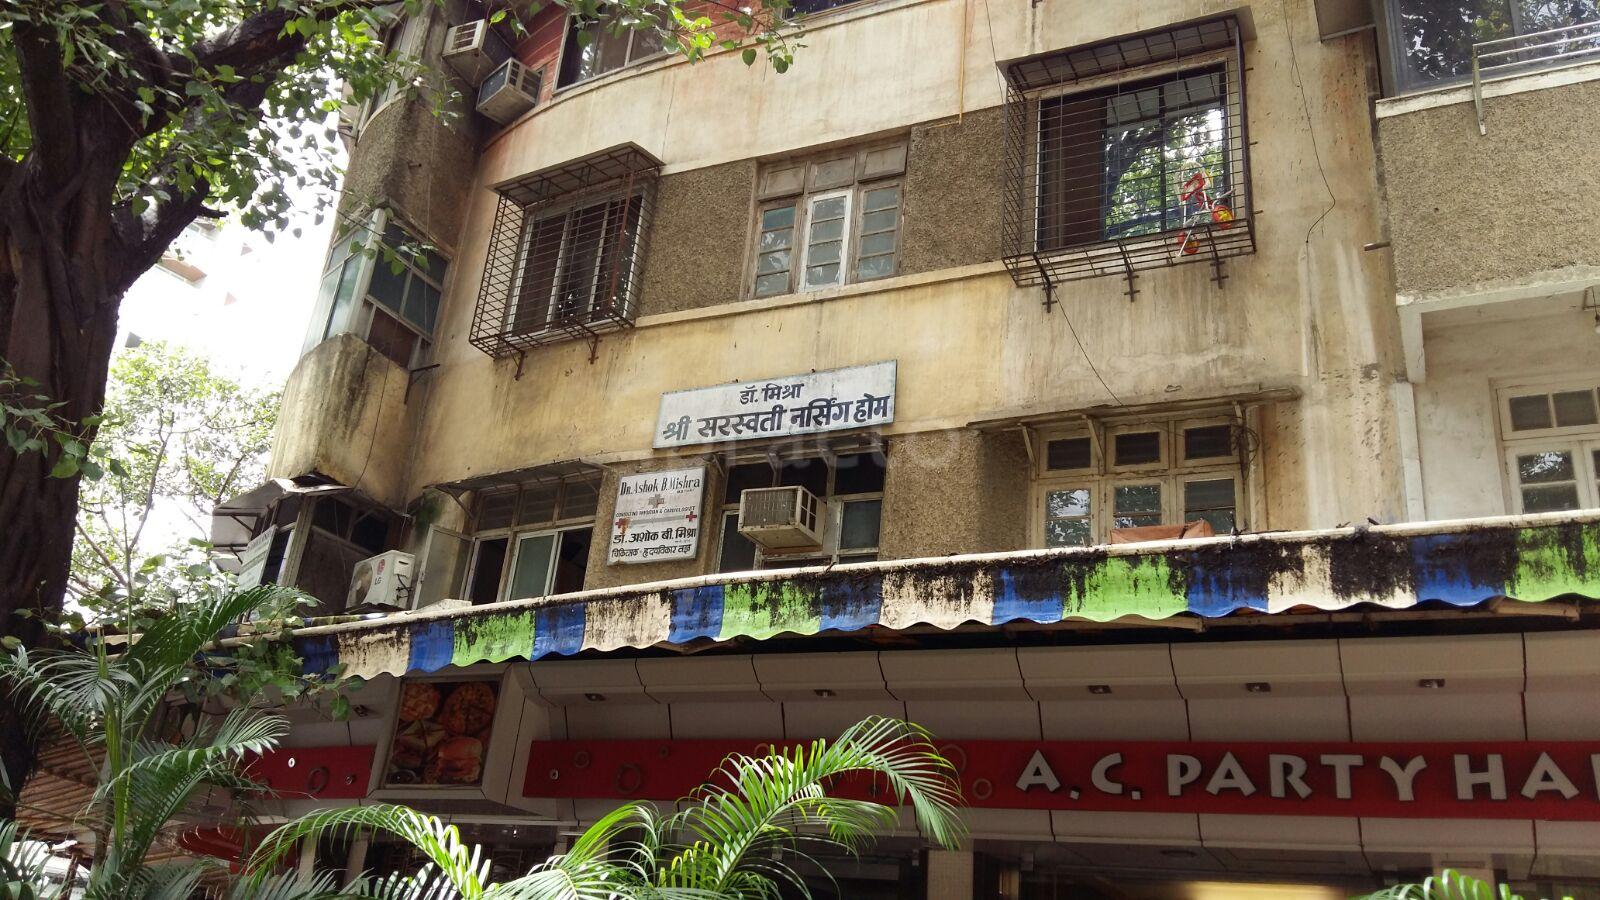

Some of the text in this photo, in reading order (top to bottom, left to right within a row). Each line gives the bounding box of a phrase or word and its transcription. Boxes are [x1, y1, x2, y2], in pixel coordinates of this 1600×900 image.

[662, 393, 890, 441] श्री सरस्वती नर्सिंग होम
[740, 382, 804, 405] डॉ. मिश्रा
[1015, 748, 1600, 804] A.C. PARTY HA
